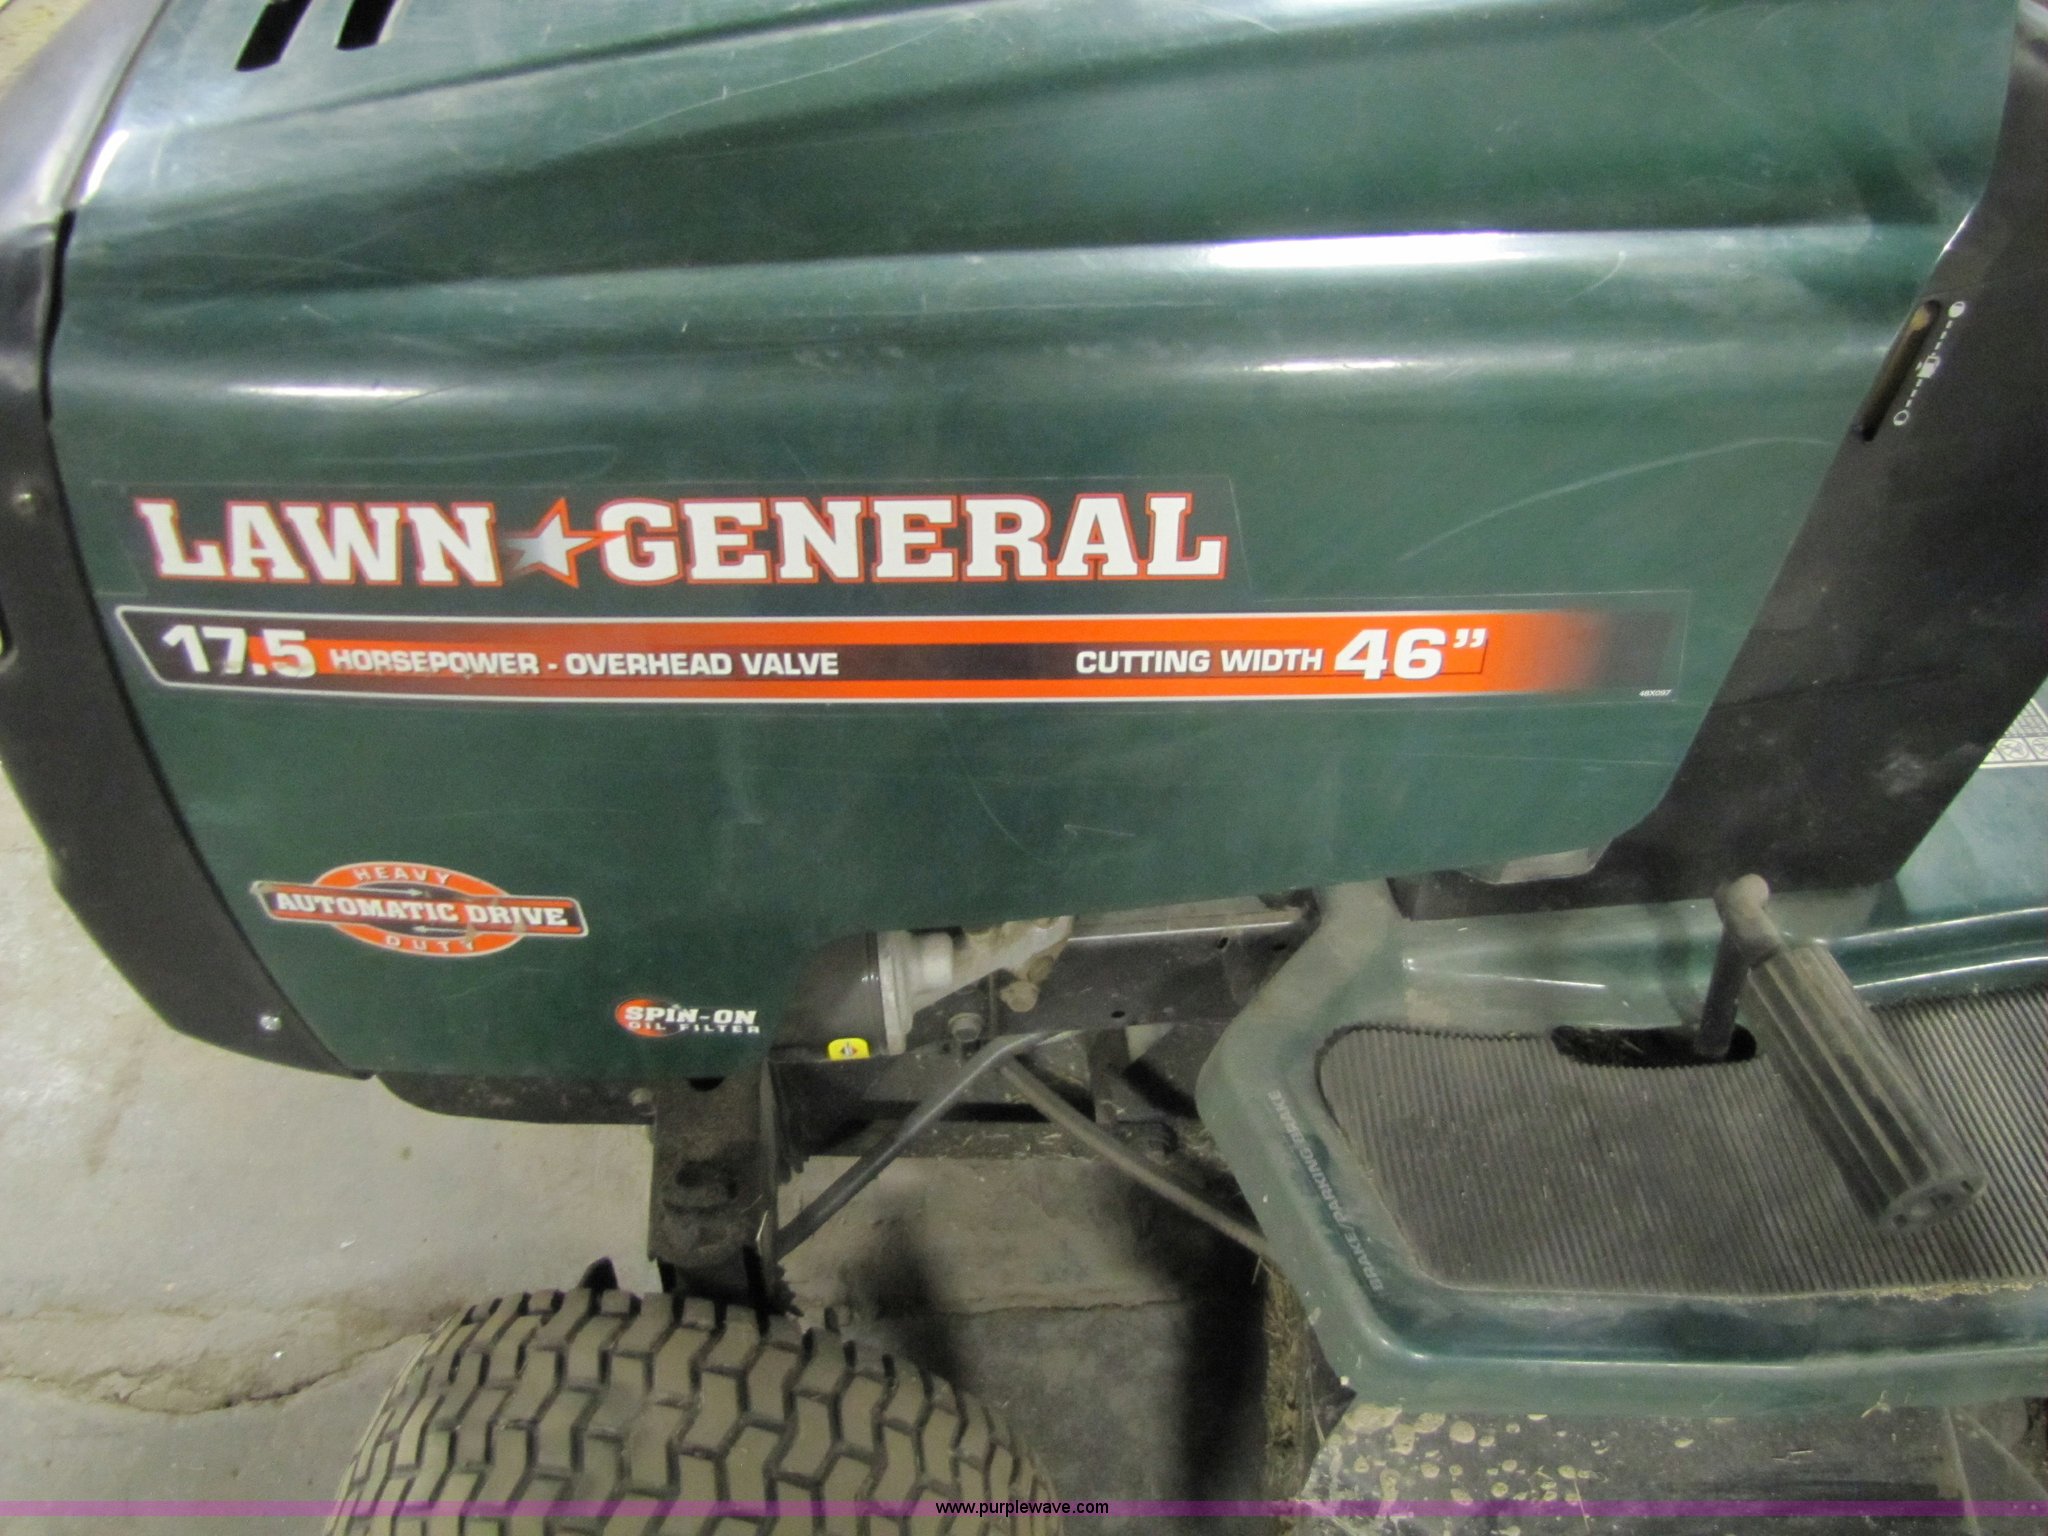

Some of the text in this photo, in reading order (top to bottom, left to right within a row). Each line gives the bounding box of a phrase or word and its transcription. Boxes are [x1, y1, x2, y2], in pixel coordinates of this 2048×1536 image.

[135, 492, 1228, 586] LAWN GENERAL
[162, 624, 317, 678] 17.5
[329, 648, 540, 676] HORSEPOWER
[566, 651, 733, 676] OVERHEAD
[741, 652, 839, 676] VALVE
[1075, 648, 1211, 674] CUTTING
[1220, 647, 1323, 672] WIDTH
[352, 865, 452, 884] HEAVY
[275, 892, 569, 927] AUTOMATIC DRIVE
[384, 934, 476, 952] DUTY
[624, 1004, 758, 1025] SPIN-ON
[628, 1021, 760, 1034] OIL FILTER
